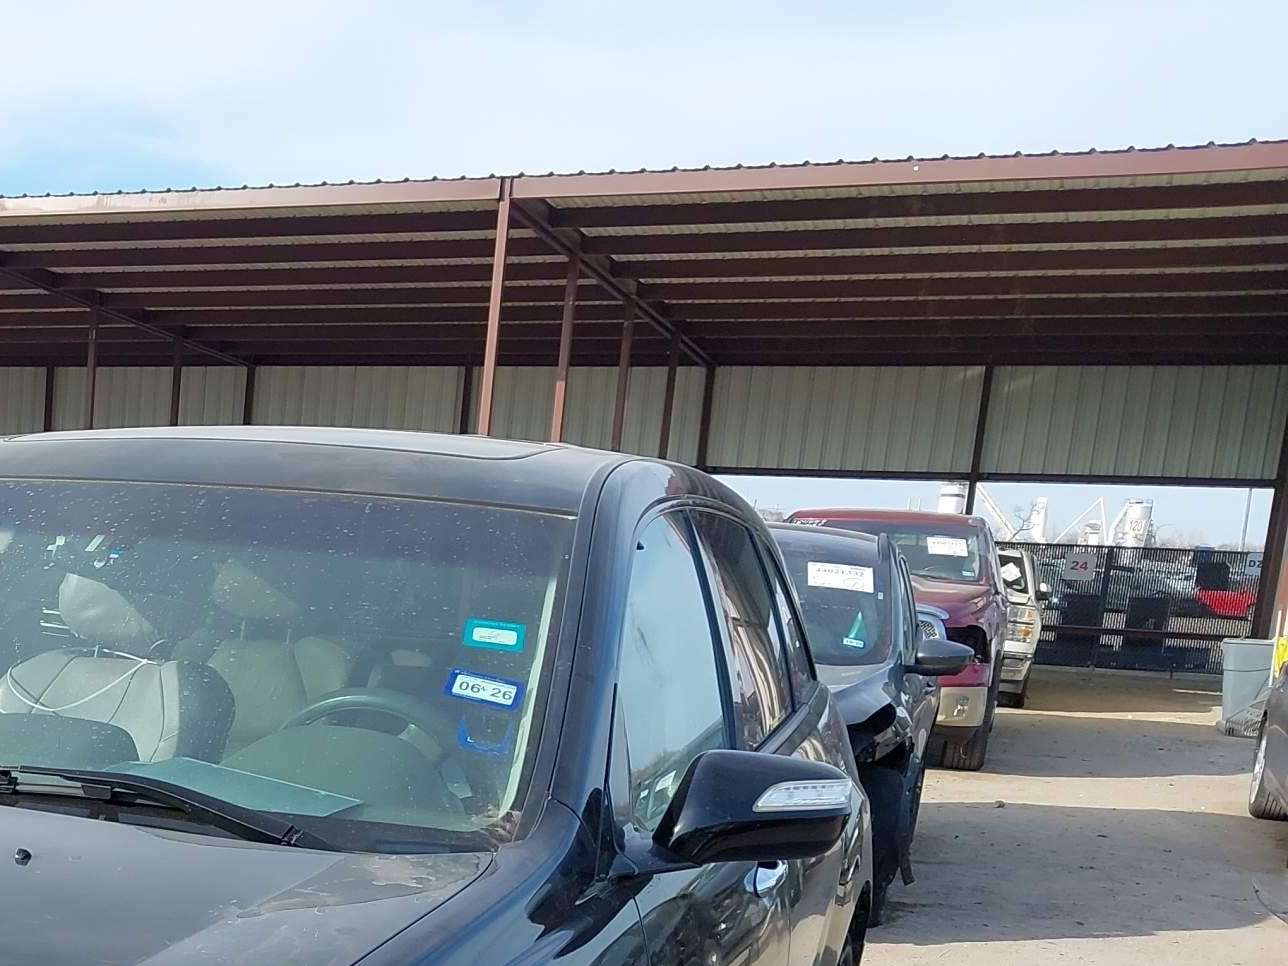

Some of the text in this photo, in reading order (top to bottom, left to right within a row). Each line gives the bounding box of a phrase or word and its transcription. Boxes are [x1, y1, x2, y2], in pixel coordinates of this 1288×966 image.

[1129, 519, 1144, 532] 120
[1070, 560, 1089, 571] 24
[458, 680, 514, 701] 06 26
